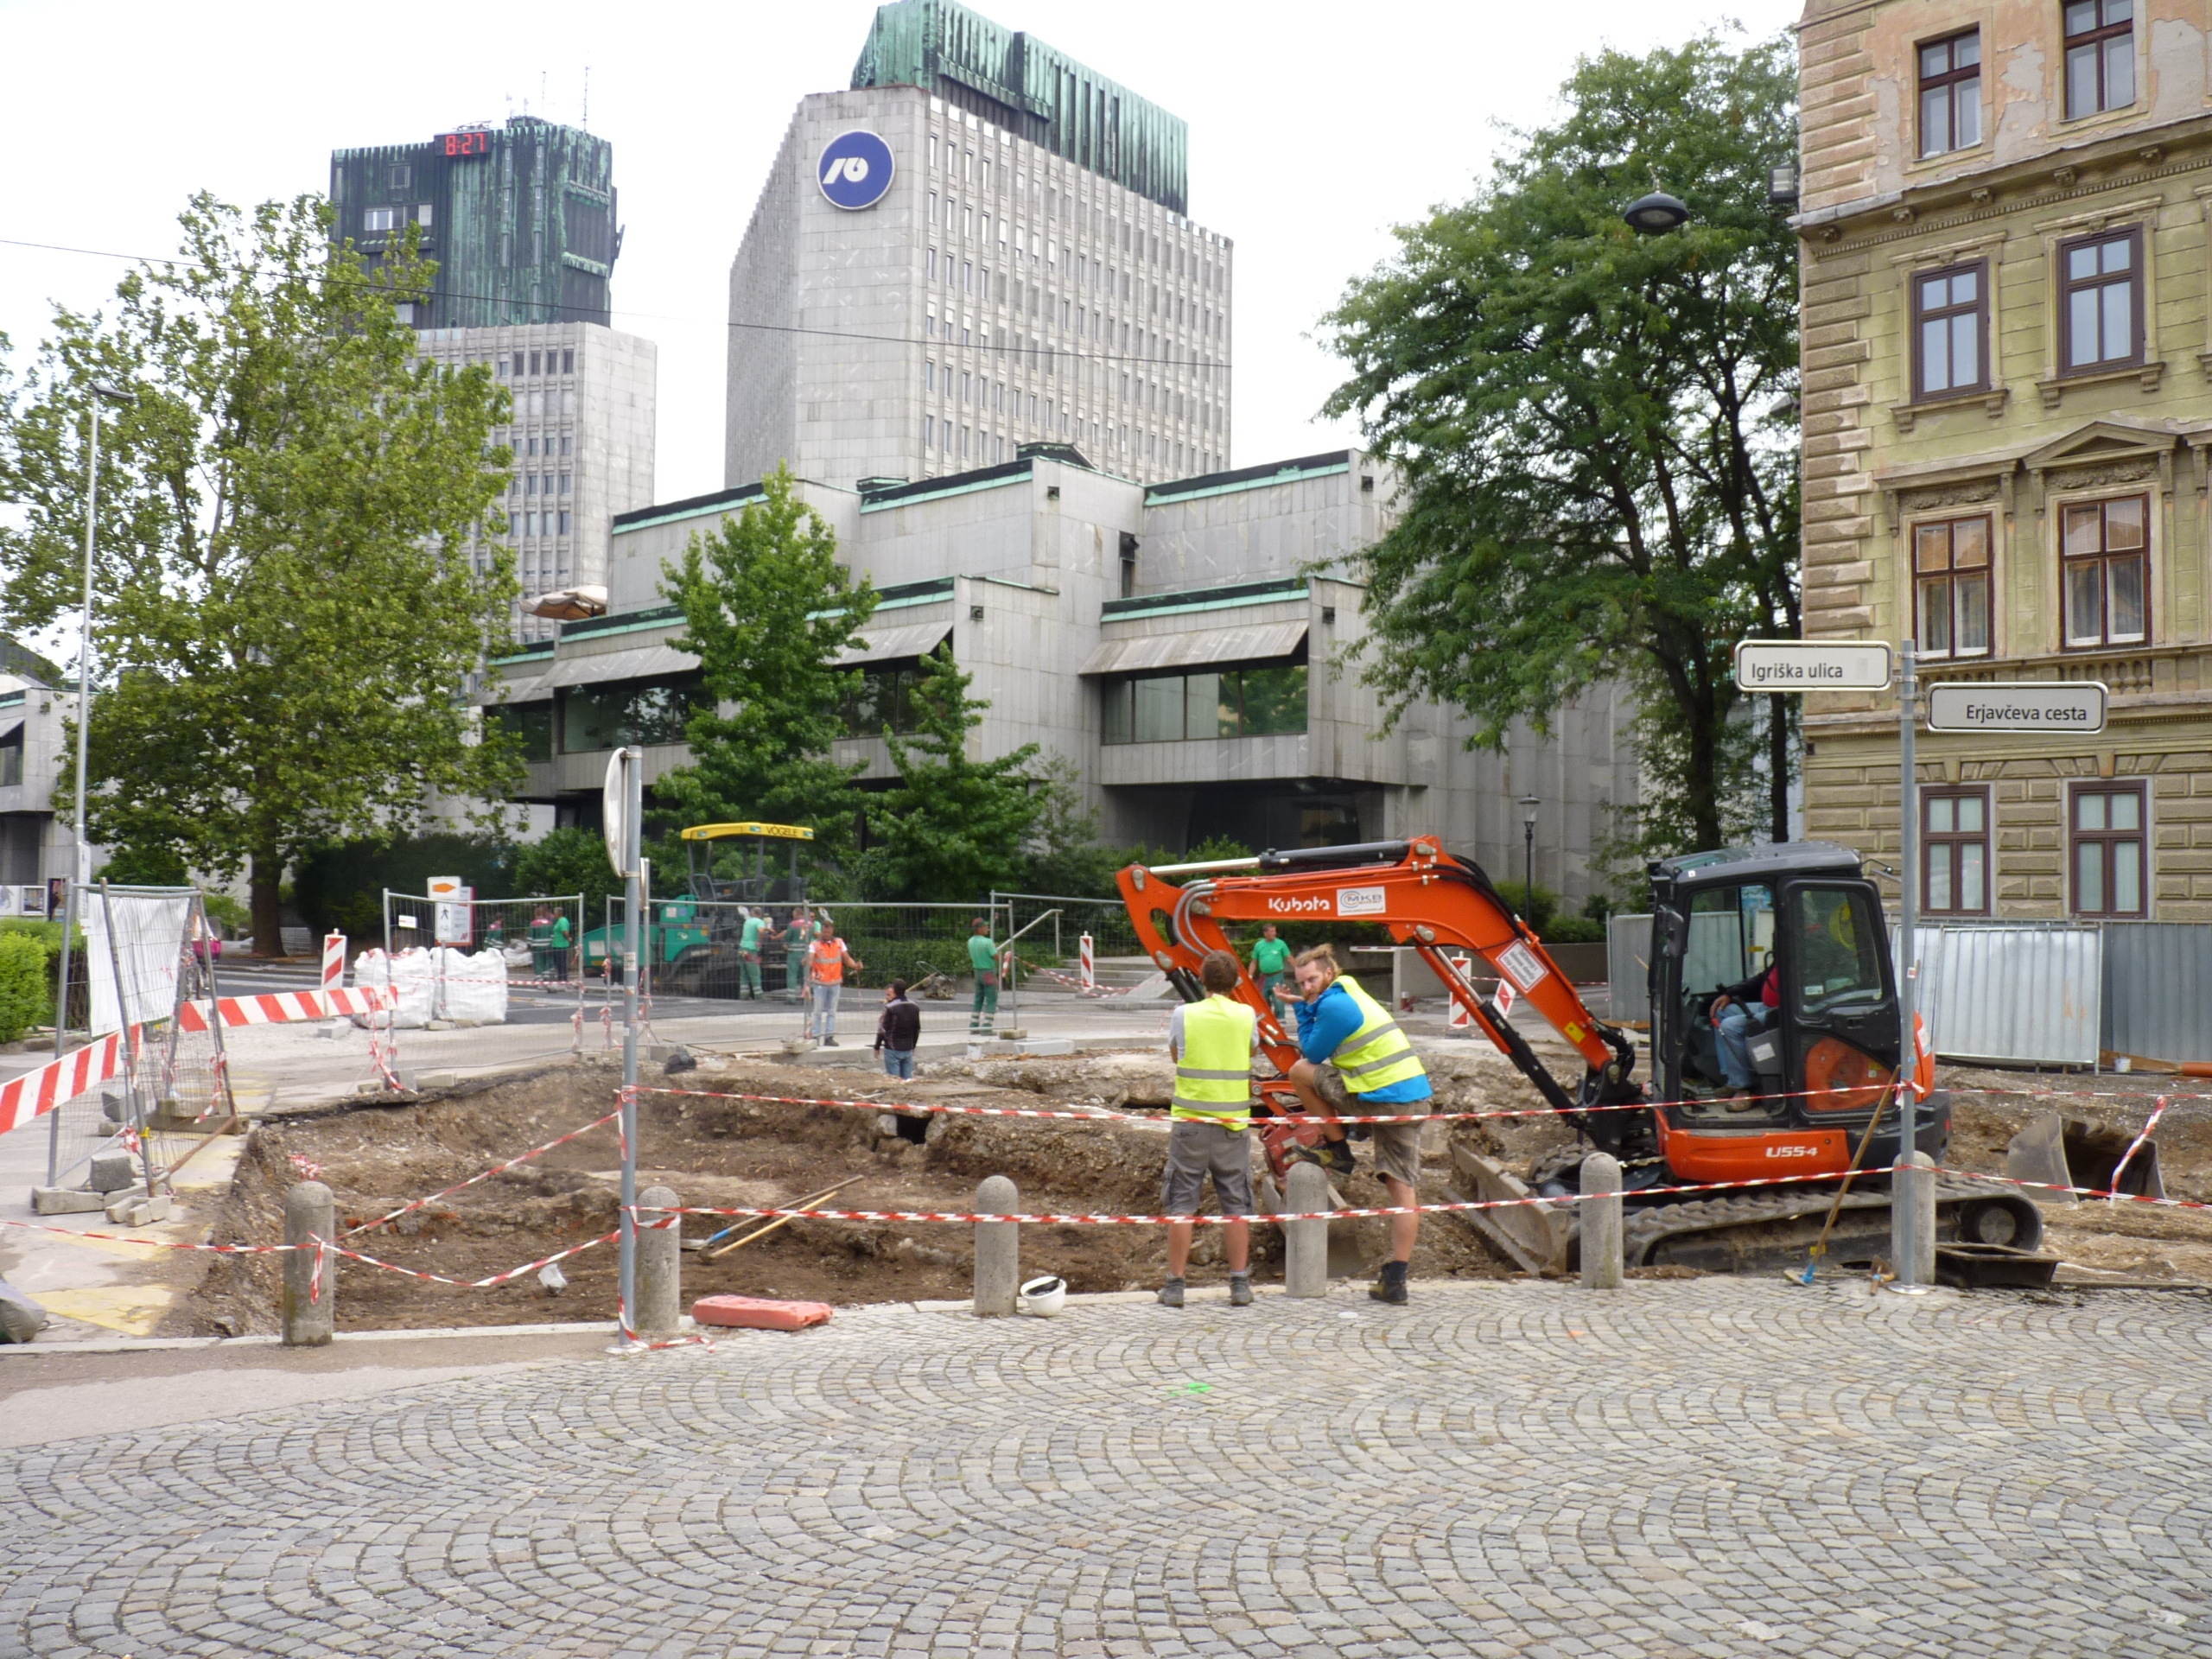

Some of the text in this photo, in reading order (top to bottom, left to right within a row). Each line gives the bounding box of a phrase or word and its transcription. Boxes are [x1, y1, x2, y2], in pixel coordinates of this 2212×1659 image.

[445, 132, 486, 156] 8:27
[1751, 663, 1843, 682] Igriška ulica
[1966, 704, 2088, 723] Erjavčeva cesta
[1268, 896, 1331, 912] Kubota
